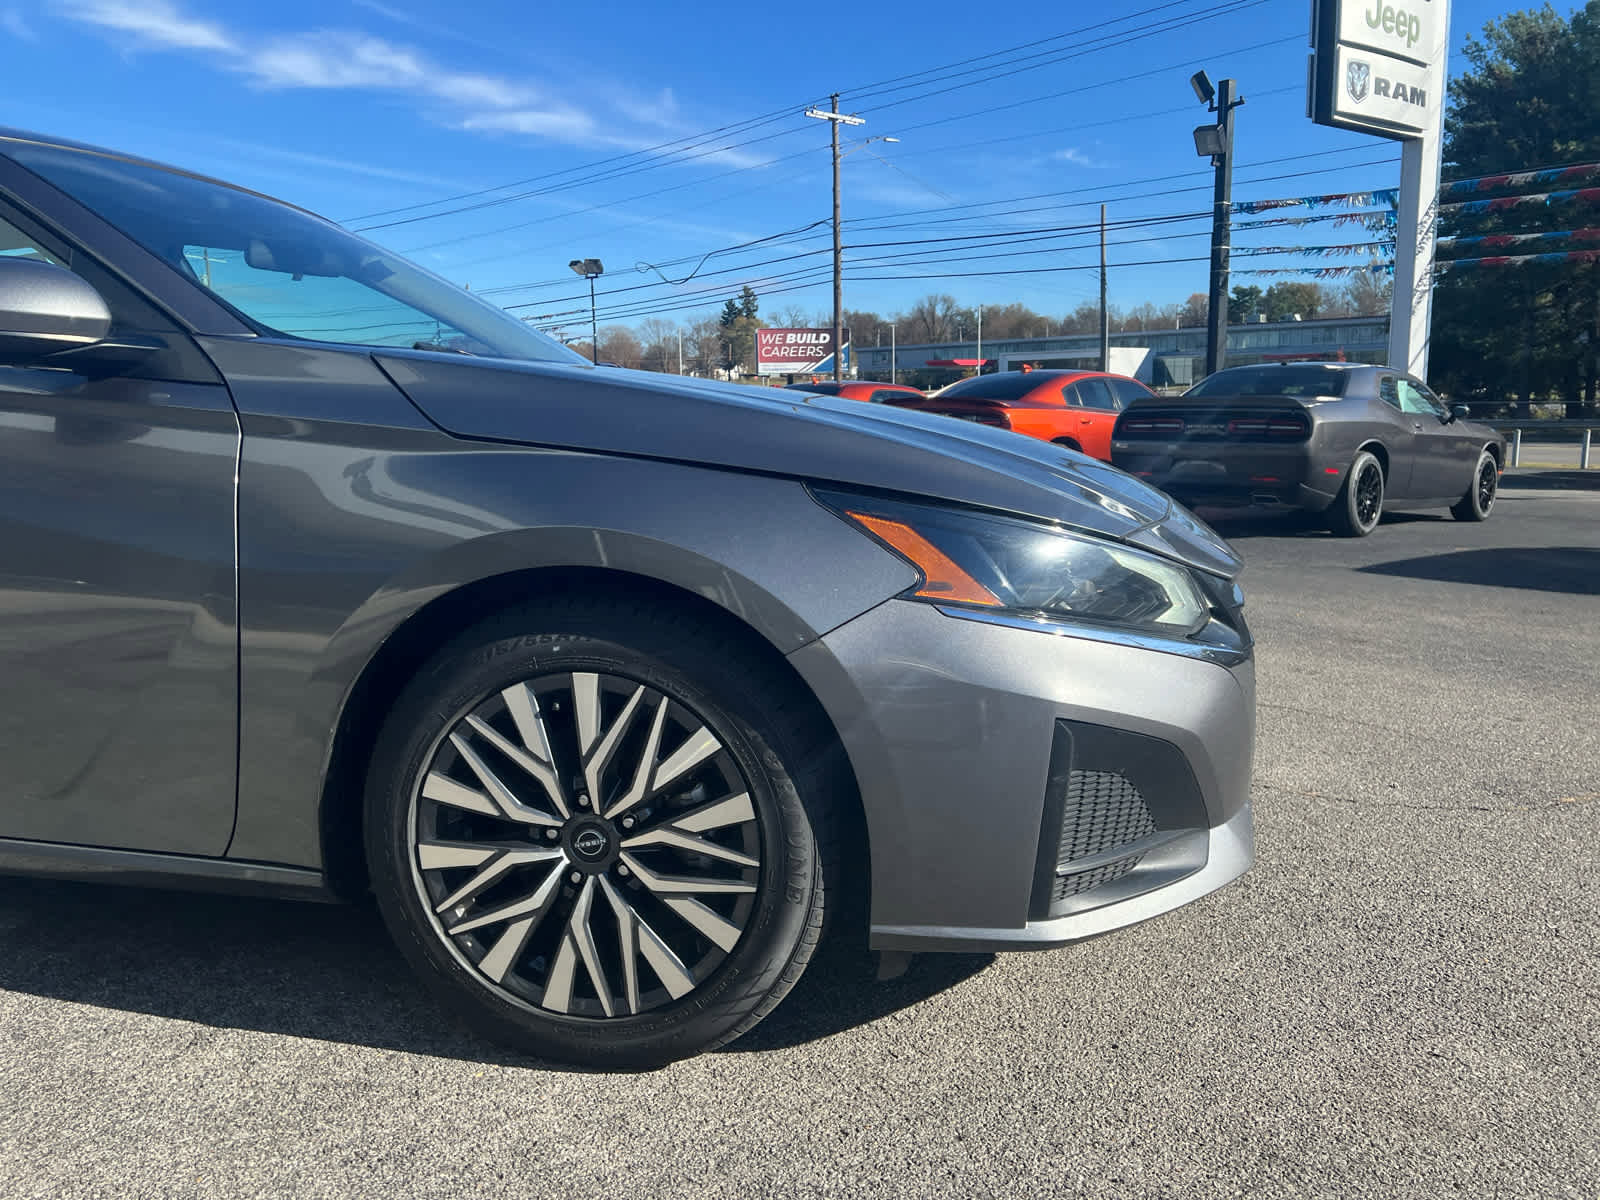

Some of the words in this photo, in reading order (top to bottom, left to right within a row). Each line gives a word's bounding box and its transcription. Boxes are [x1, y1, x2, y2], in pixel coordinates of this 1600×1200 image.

[1366, 0, 1420, 48] Jeep
[1374, 77, 1426, 107] RAM
[761, 333, 784, 344] WE
[786, 333, 830, 344] BUILD
[761, 346, 826, 357] CAREERS.
